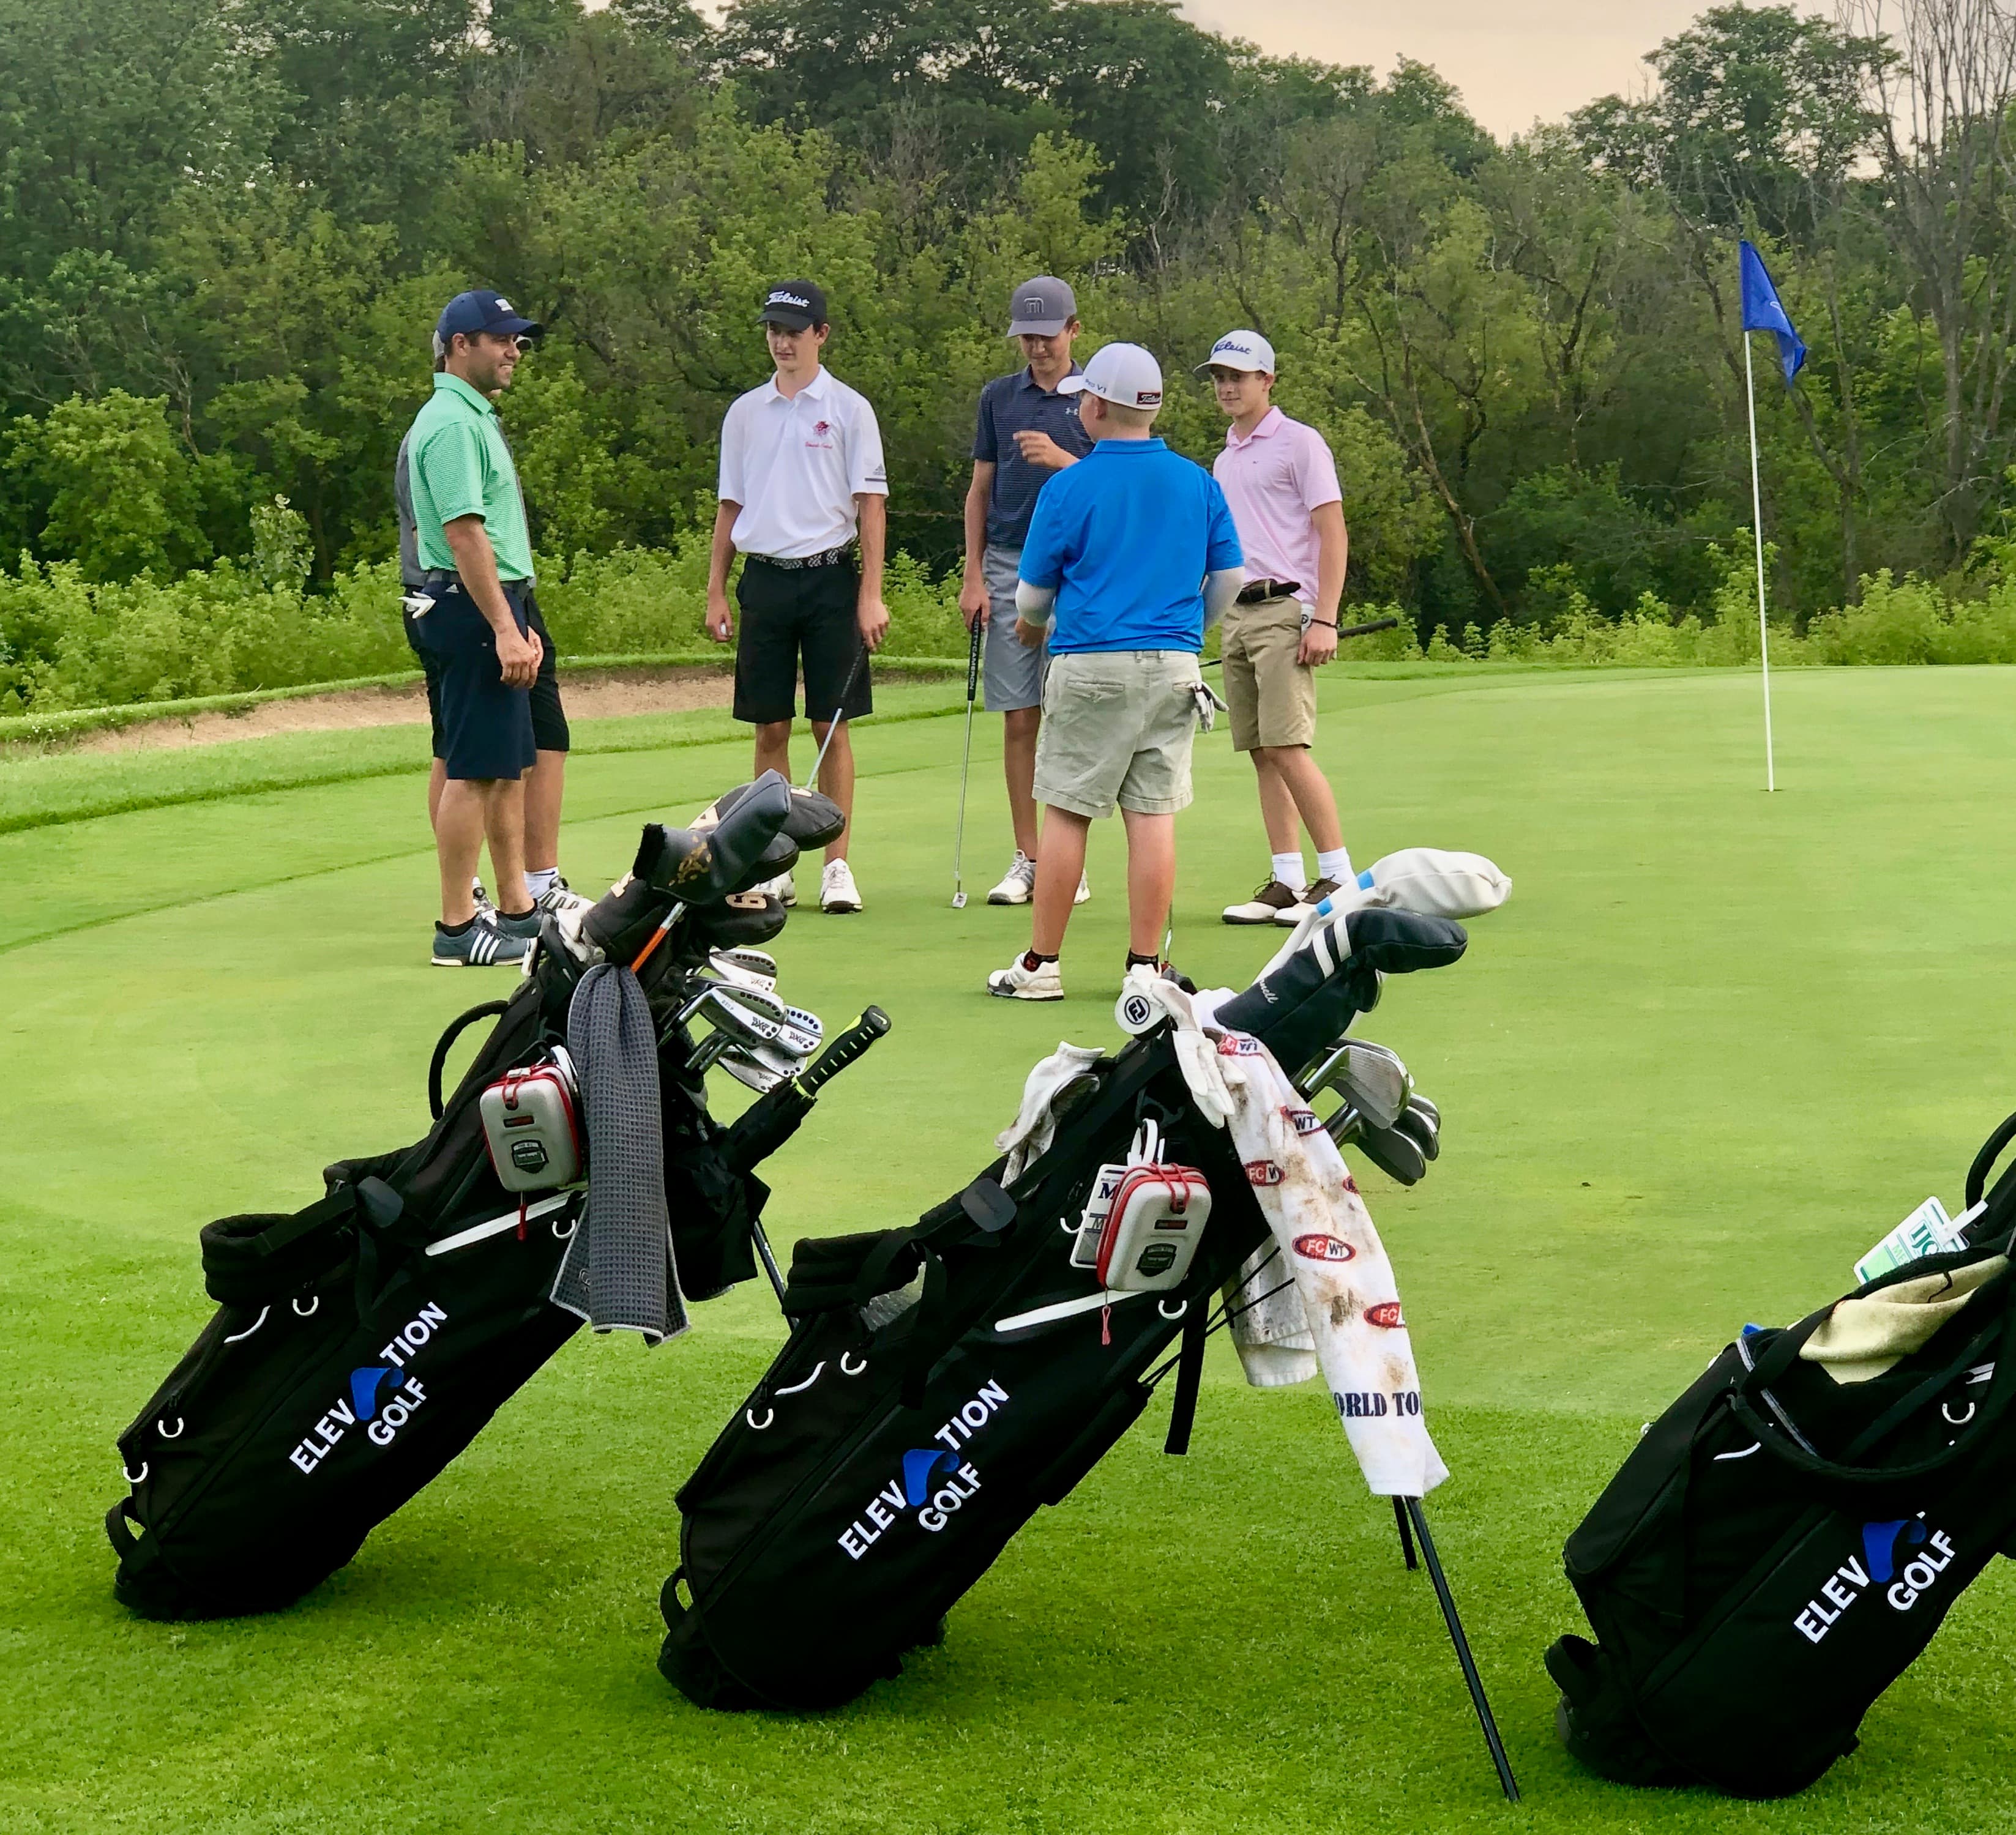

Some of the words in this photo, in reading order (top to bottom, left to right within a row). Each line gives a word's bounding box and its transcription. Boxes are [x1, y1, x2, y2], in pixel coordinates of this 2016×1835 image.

[367, 1376, 427, 1446] GOLF
[1392, 1391, 1424, 1416] TO
[918, 1462, 982, 1532] GOLF
[1887, 1530, 1956, 1611] GOLF
